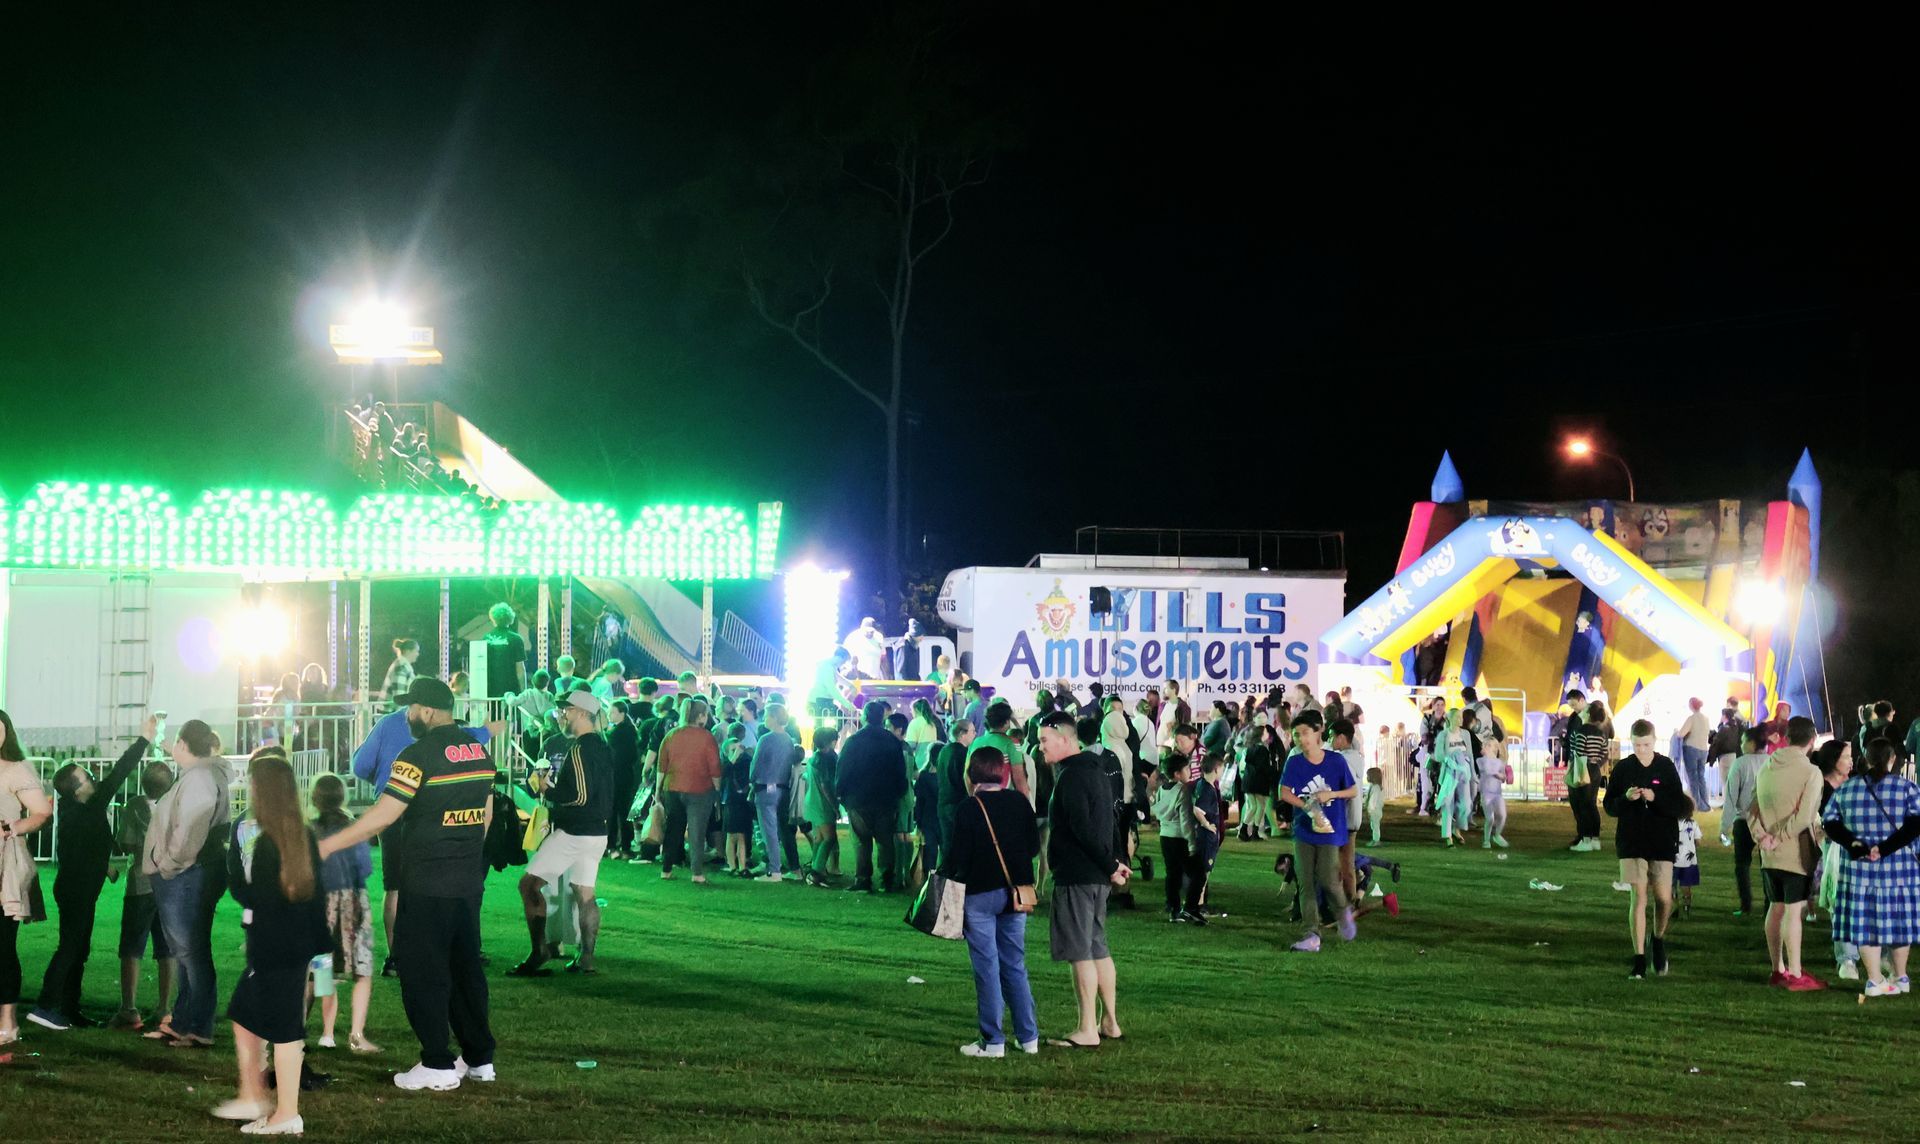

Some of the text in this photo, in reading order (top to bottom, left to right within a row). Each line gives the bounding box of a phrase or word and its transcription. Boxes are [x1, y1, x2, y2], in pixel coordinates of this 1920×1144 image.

[1001, 629, 1310, 681] Amusements
[1197, 683, 1215, 694] Ph.
[445, 743, 486, 763] OAK
